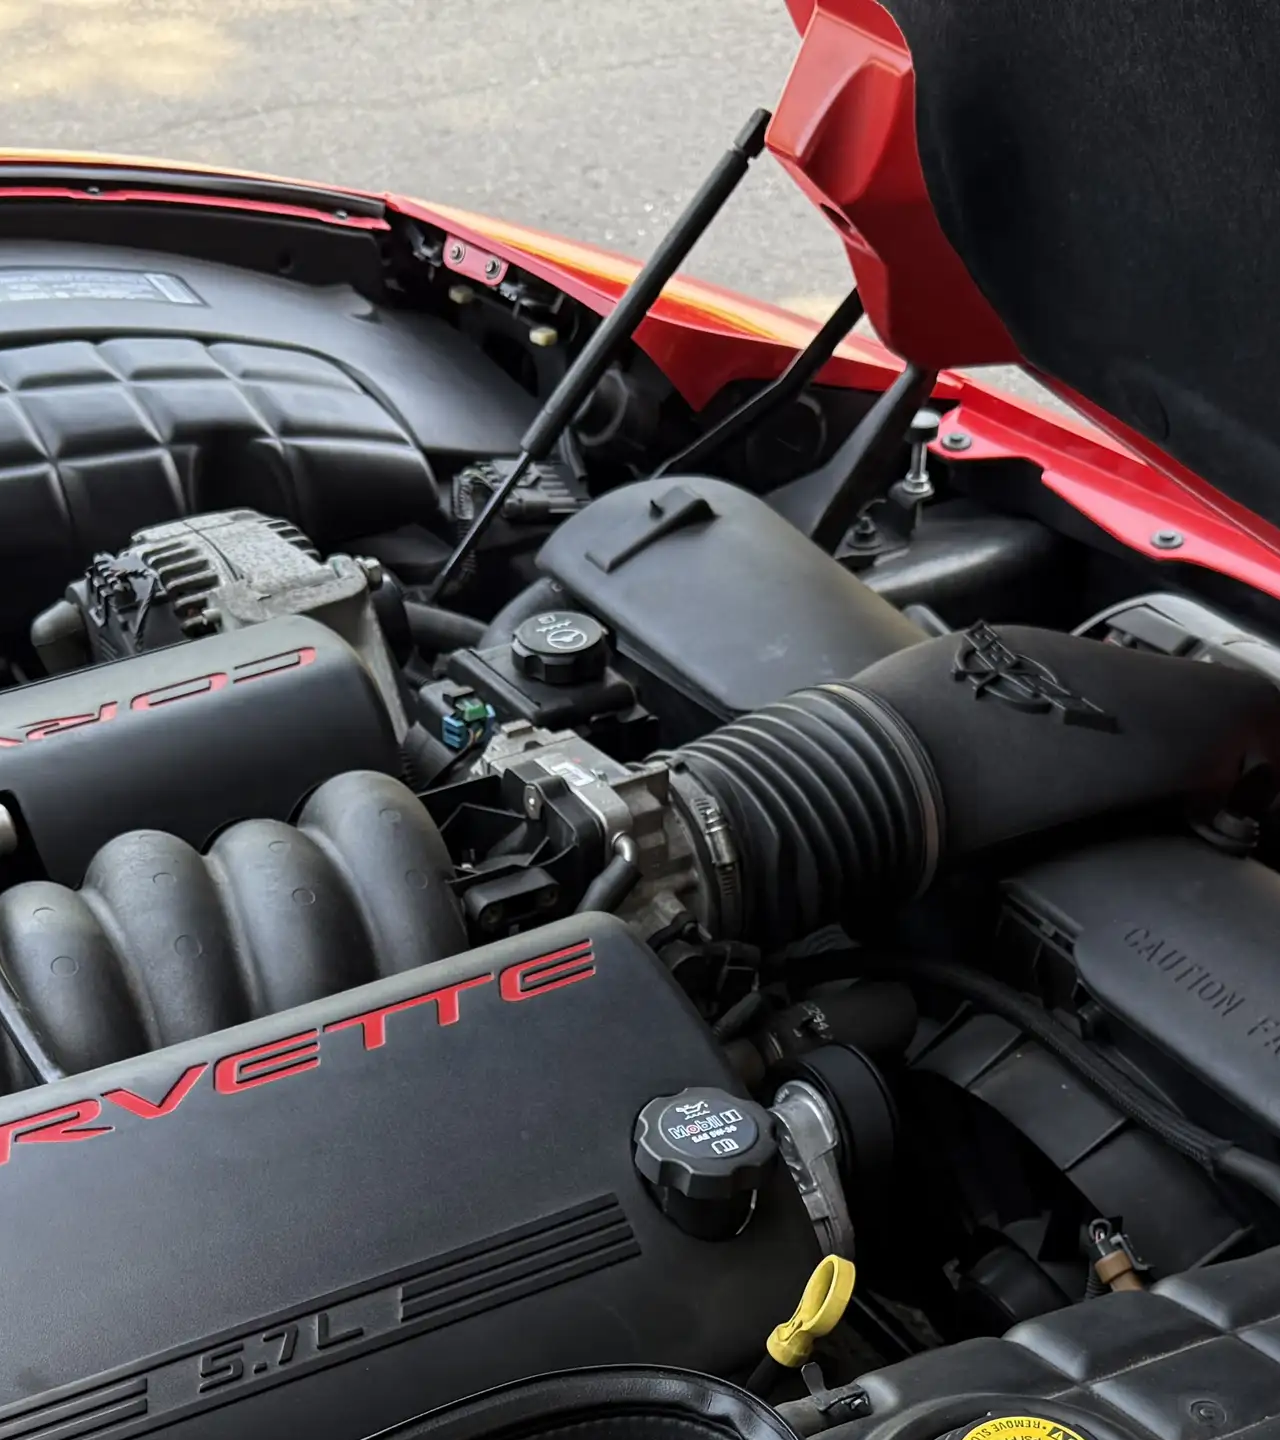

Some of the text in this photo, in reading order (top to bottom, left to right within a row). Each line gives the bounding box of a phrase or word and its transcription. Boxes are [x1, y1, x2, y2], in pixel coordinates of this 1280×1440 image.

[1124, 927, 1245, 1017] CAUTION
[668, 1115, 723, 1140] Mobil
[199, 1310, 365, 1391] 5.7L
[995, 1420, 1041, 1432] REMOVE
